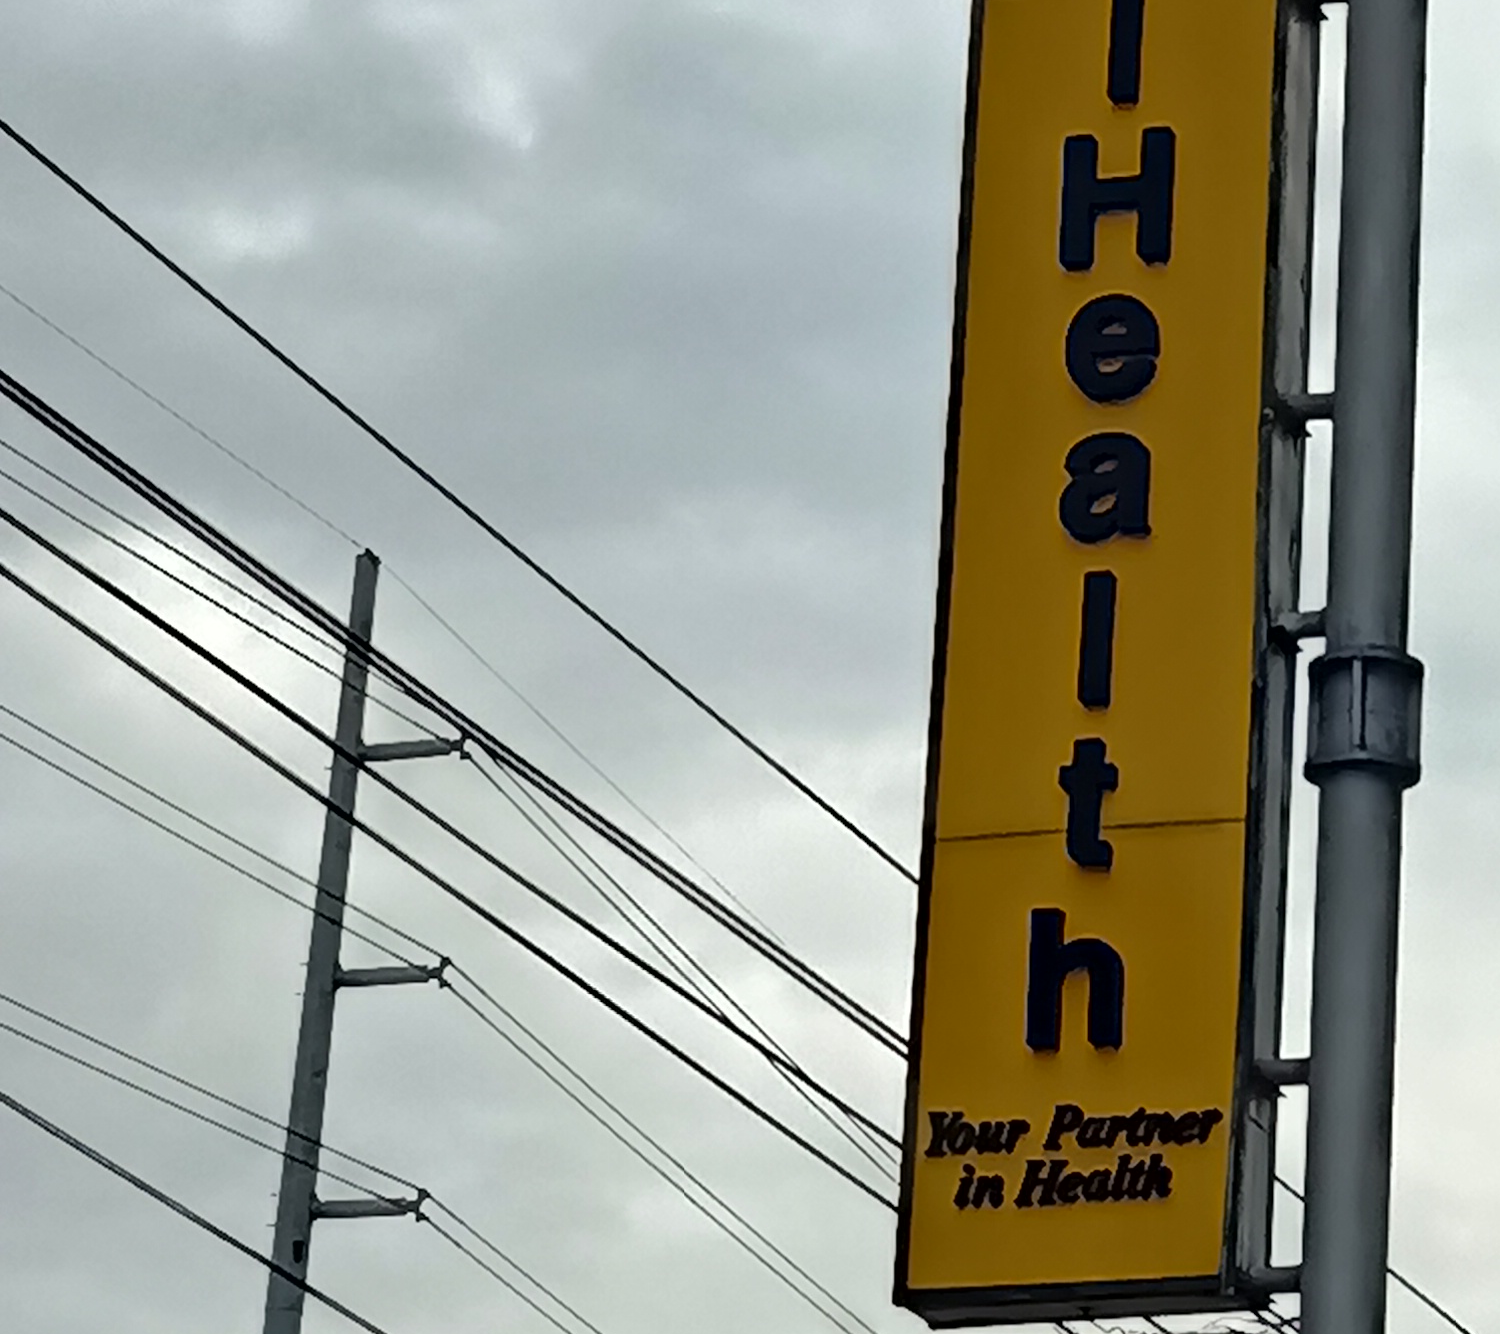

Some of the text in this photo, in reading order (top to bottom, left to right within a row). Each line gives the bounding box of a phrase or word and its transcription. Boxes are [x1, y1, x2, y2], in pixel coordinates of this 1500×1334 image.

[924, 1104, 1224, 1158] Your Partner
[953, 1153, 1174, 1210] in Health
